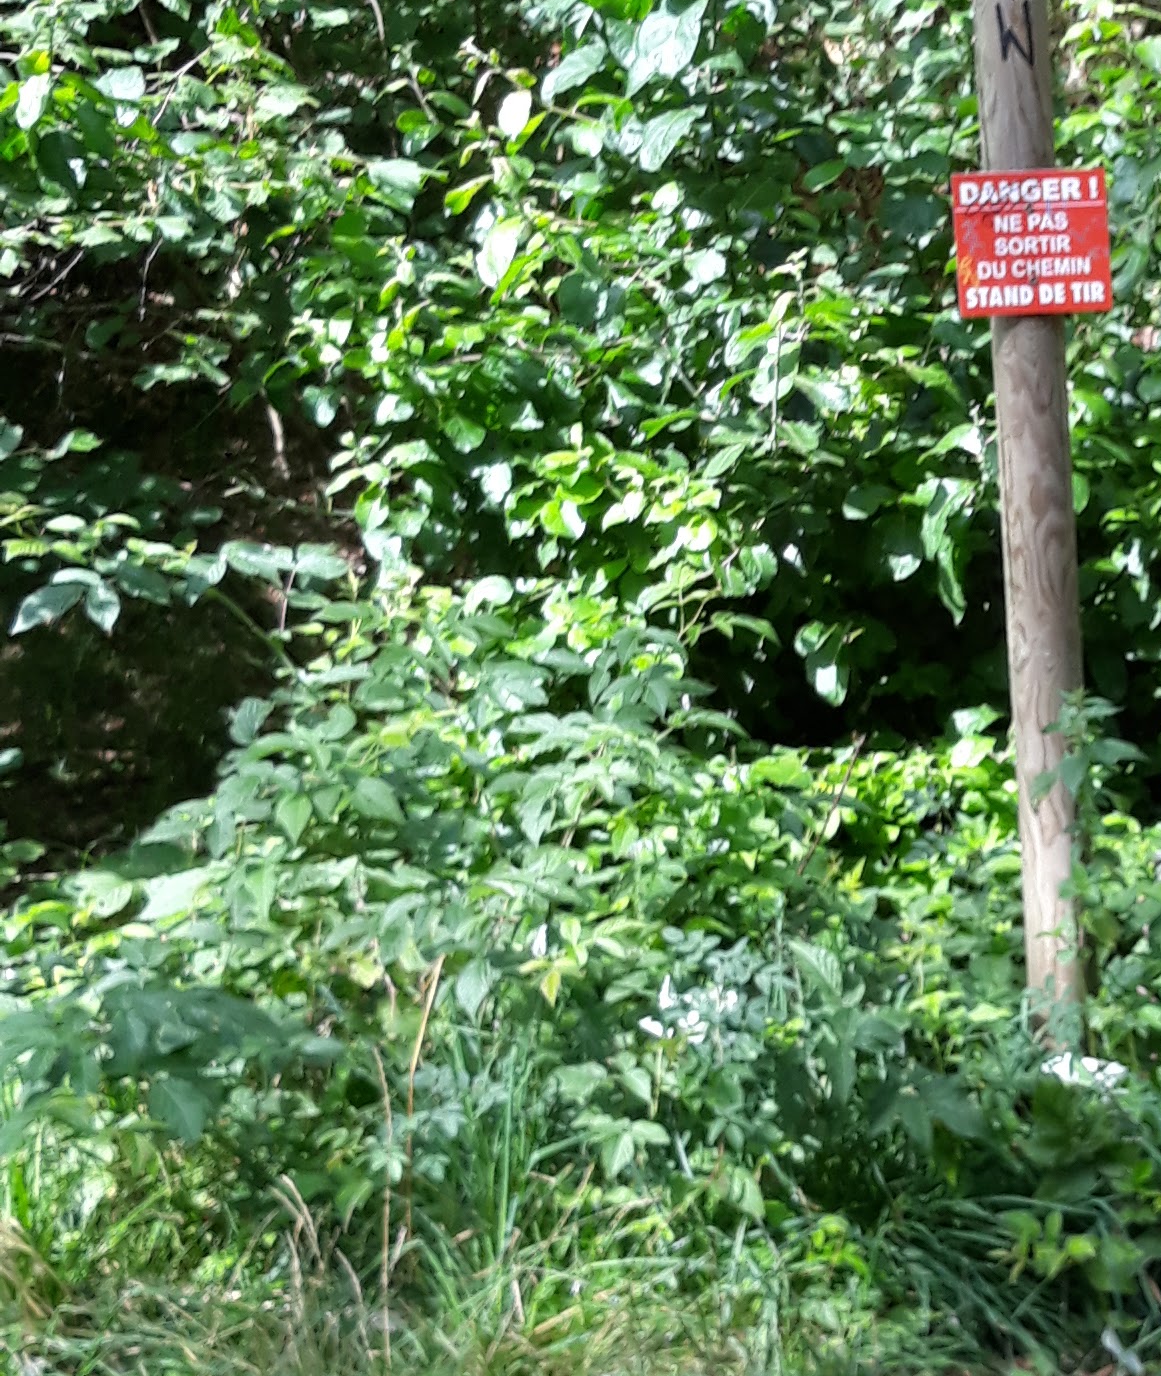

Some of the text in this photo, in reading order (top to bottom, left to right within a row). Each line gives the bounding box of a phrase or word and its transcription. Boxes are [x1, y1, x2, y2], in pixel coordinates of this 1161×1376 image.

[958, 176, 1083, 207] DANGER
[993, 210, 1069, 234] NE PAS
[994, 234, 1071, 257] SORTIR
[976, 256, 1092, 281] DU CHEMIN
[965, 280, 1105, 310] STAND DE TIR
